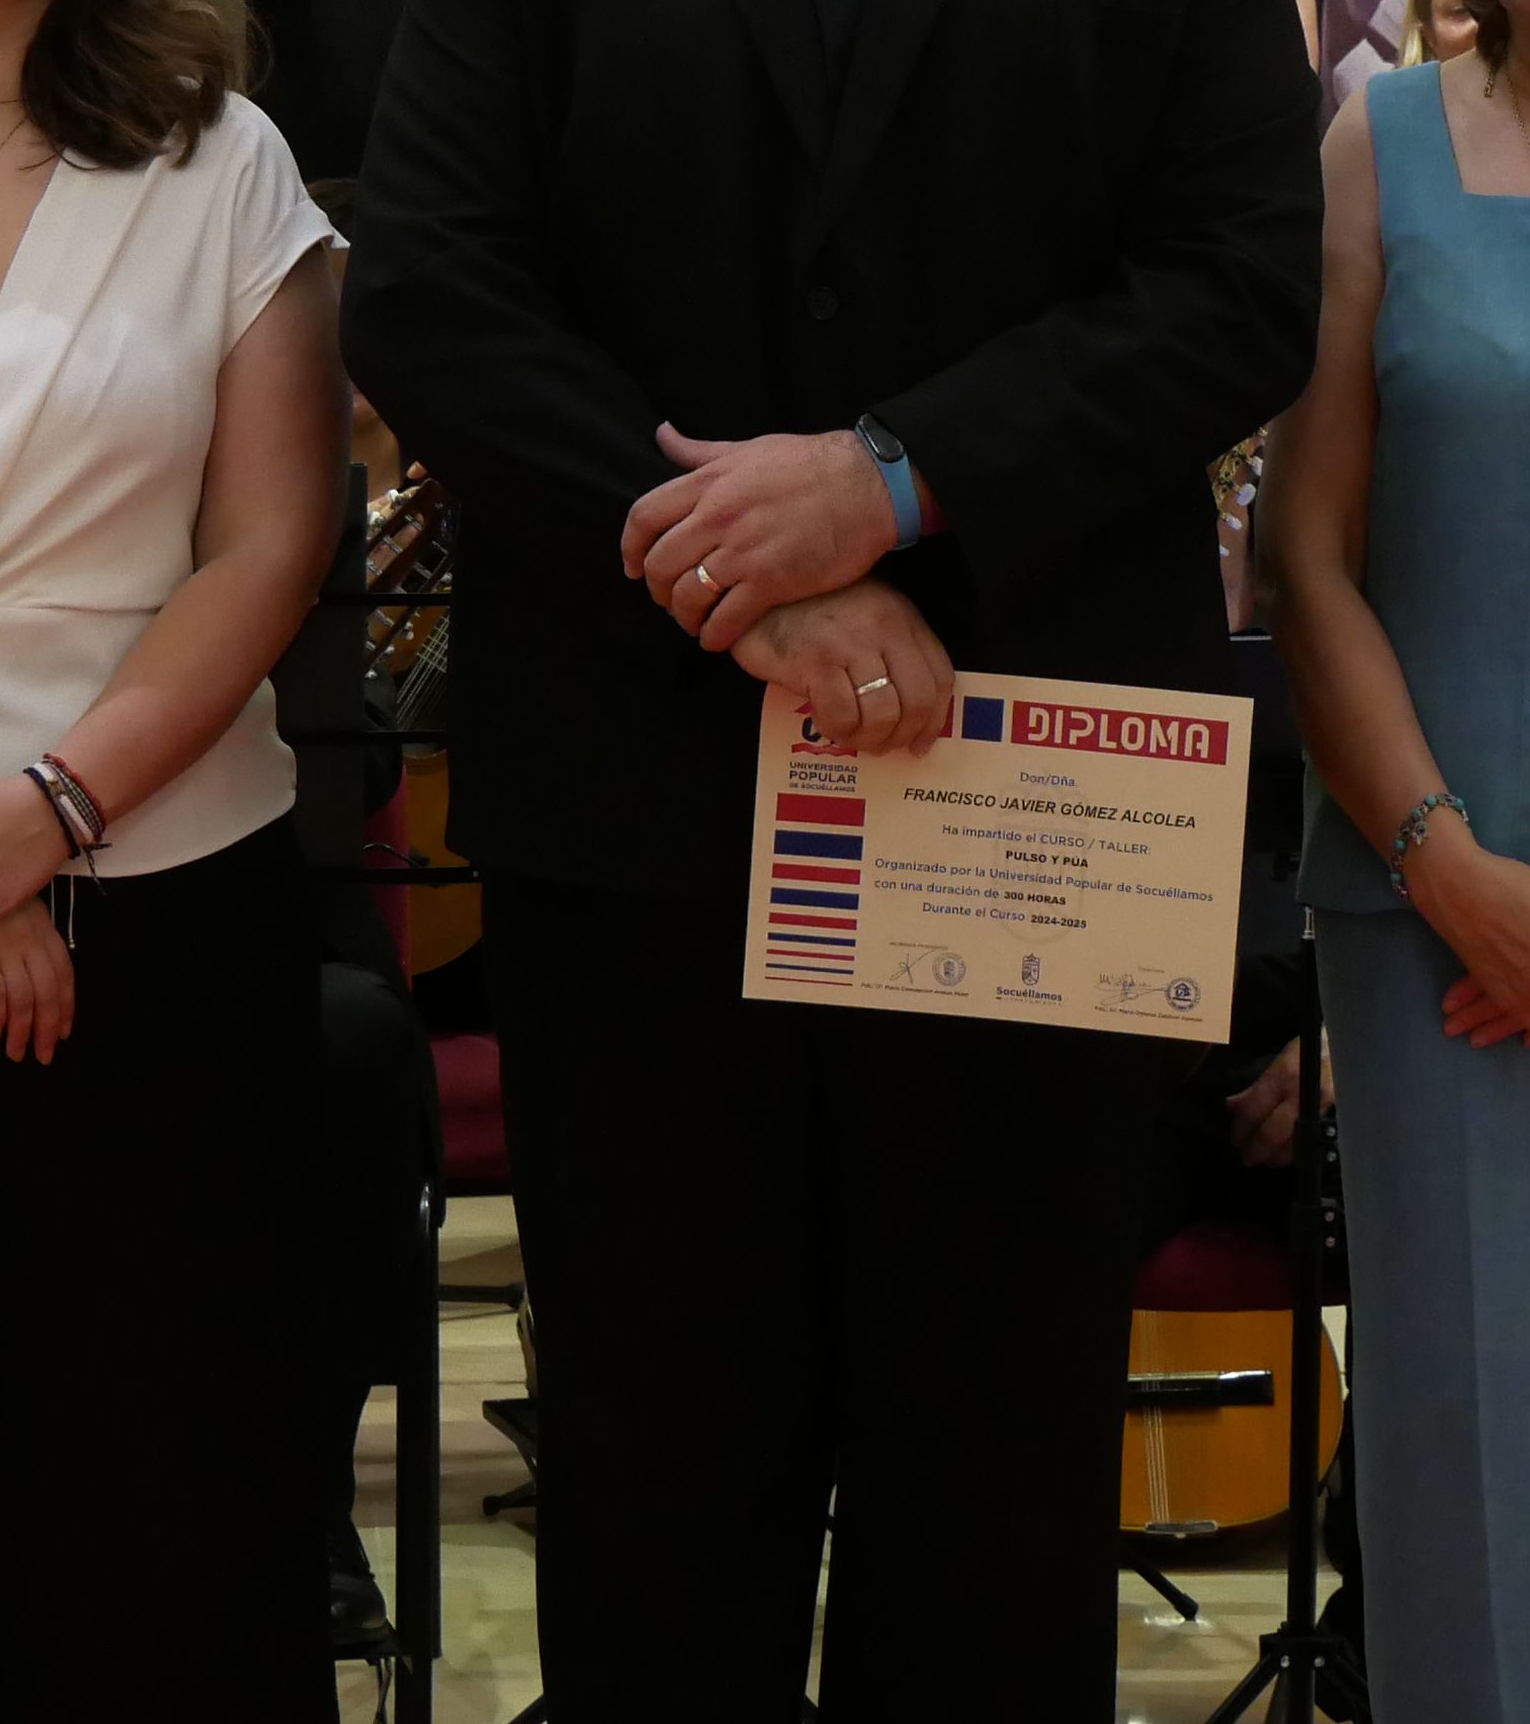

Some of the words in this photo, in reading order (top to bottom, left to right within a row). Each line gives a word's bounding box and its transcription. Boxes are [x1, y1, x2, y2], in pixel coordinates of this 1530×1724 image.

[1027, 706, 1210, 759] DIPLOMA
[789, 761, 858, 773] UNIVERSIDAD
[789, 770, 857, 784] POPULAR
[903, 787, 997, 808] FRANCISCO
[999, 796, 1057, 815] JAVIER
[1060, 800, 1118, 822] GÓMEZ
[1120, 808, 1197, 829] ALCOLEA
[942, 823, 959, 836] Ha
[962, 825, 1023, 842] impartido
[1025, 832, 1037, 844] el
[1039, 833, 1085, 849] CURSO
[1098, 839, 1152, 856] TALLER:
[1005, 849, 1048, 864] PULSO
[1051, 855, 1060, 865] Y
[1062, 855, 1089, 869] PÚA
[874, 857, 947, 874] Organizado
[950, 864, 972, 878] por
[975, 865, 986, 877] la
[989, 867, 1063, 886] Universidad
[1065, 876, 1113, 891] Popular
[1116, 881, 1132, 894] de
[1136, 883, 1214, 903] Socuéllamos
[874, 878, 897, 890] con
[900, 881, 923, 892] una
[926, 881, 981, 897] duración
[984, 887, 1000, 900] de
[1004, 890, 1025, 902] 300
[1027, 893, 1066, 906] HORAS
[922, 901, 972, 917] Durante
[975, 906, 987, 918] el
[989, 908, 1026, 922] Curso
[1030, 913, 1088, 929] 2024-2025
[996, 985, 1063, 1003] Socuéllamos
